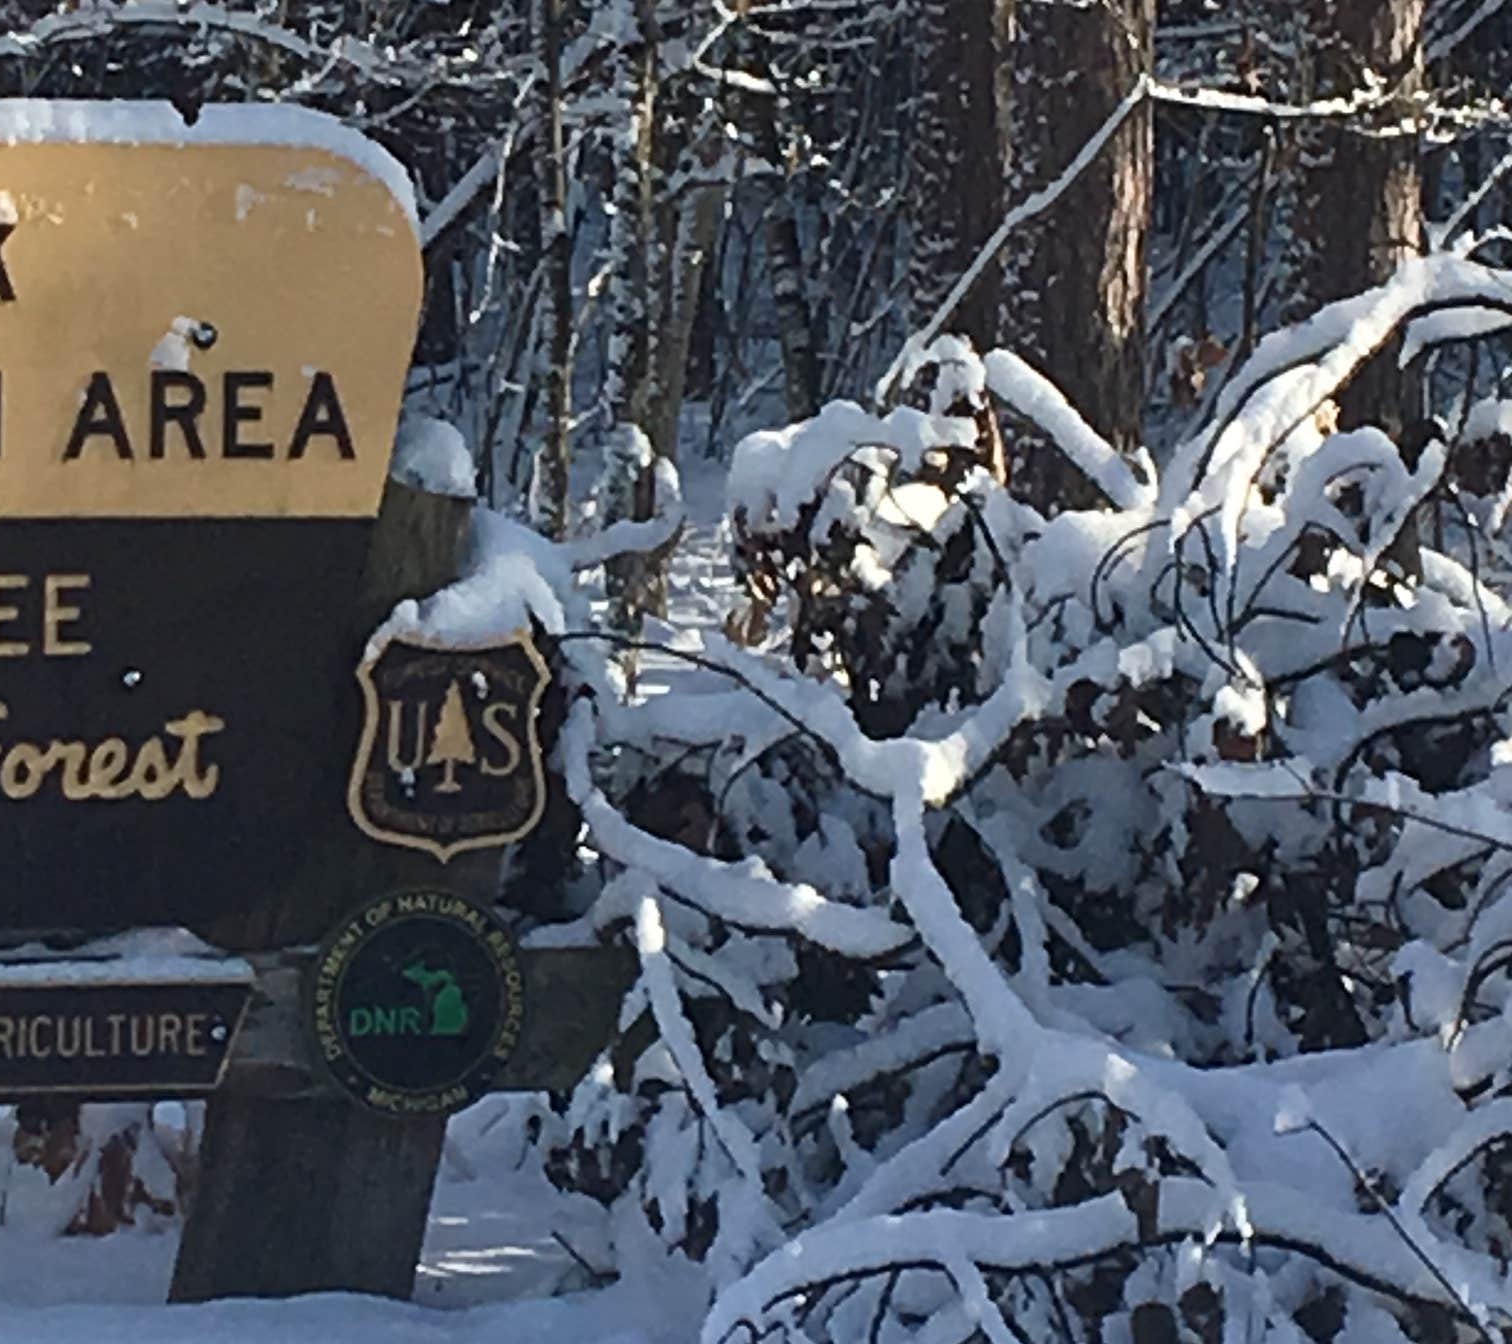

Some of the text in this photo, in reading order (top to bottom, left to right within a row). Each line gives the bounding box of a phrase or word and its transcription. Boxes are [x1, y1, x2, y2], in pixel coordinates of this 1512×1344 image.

[66, 370, 358, 462] AREA
[316, 895, 523, 1060] DEPARTMENT OF NATURAL RESOURCES
[350, 1007, 422, 1037] DNR
[368, 1086, 468, 1112] MICHIGAN
